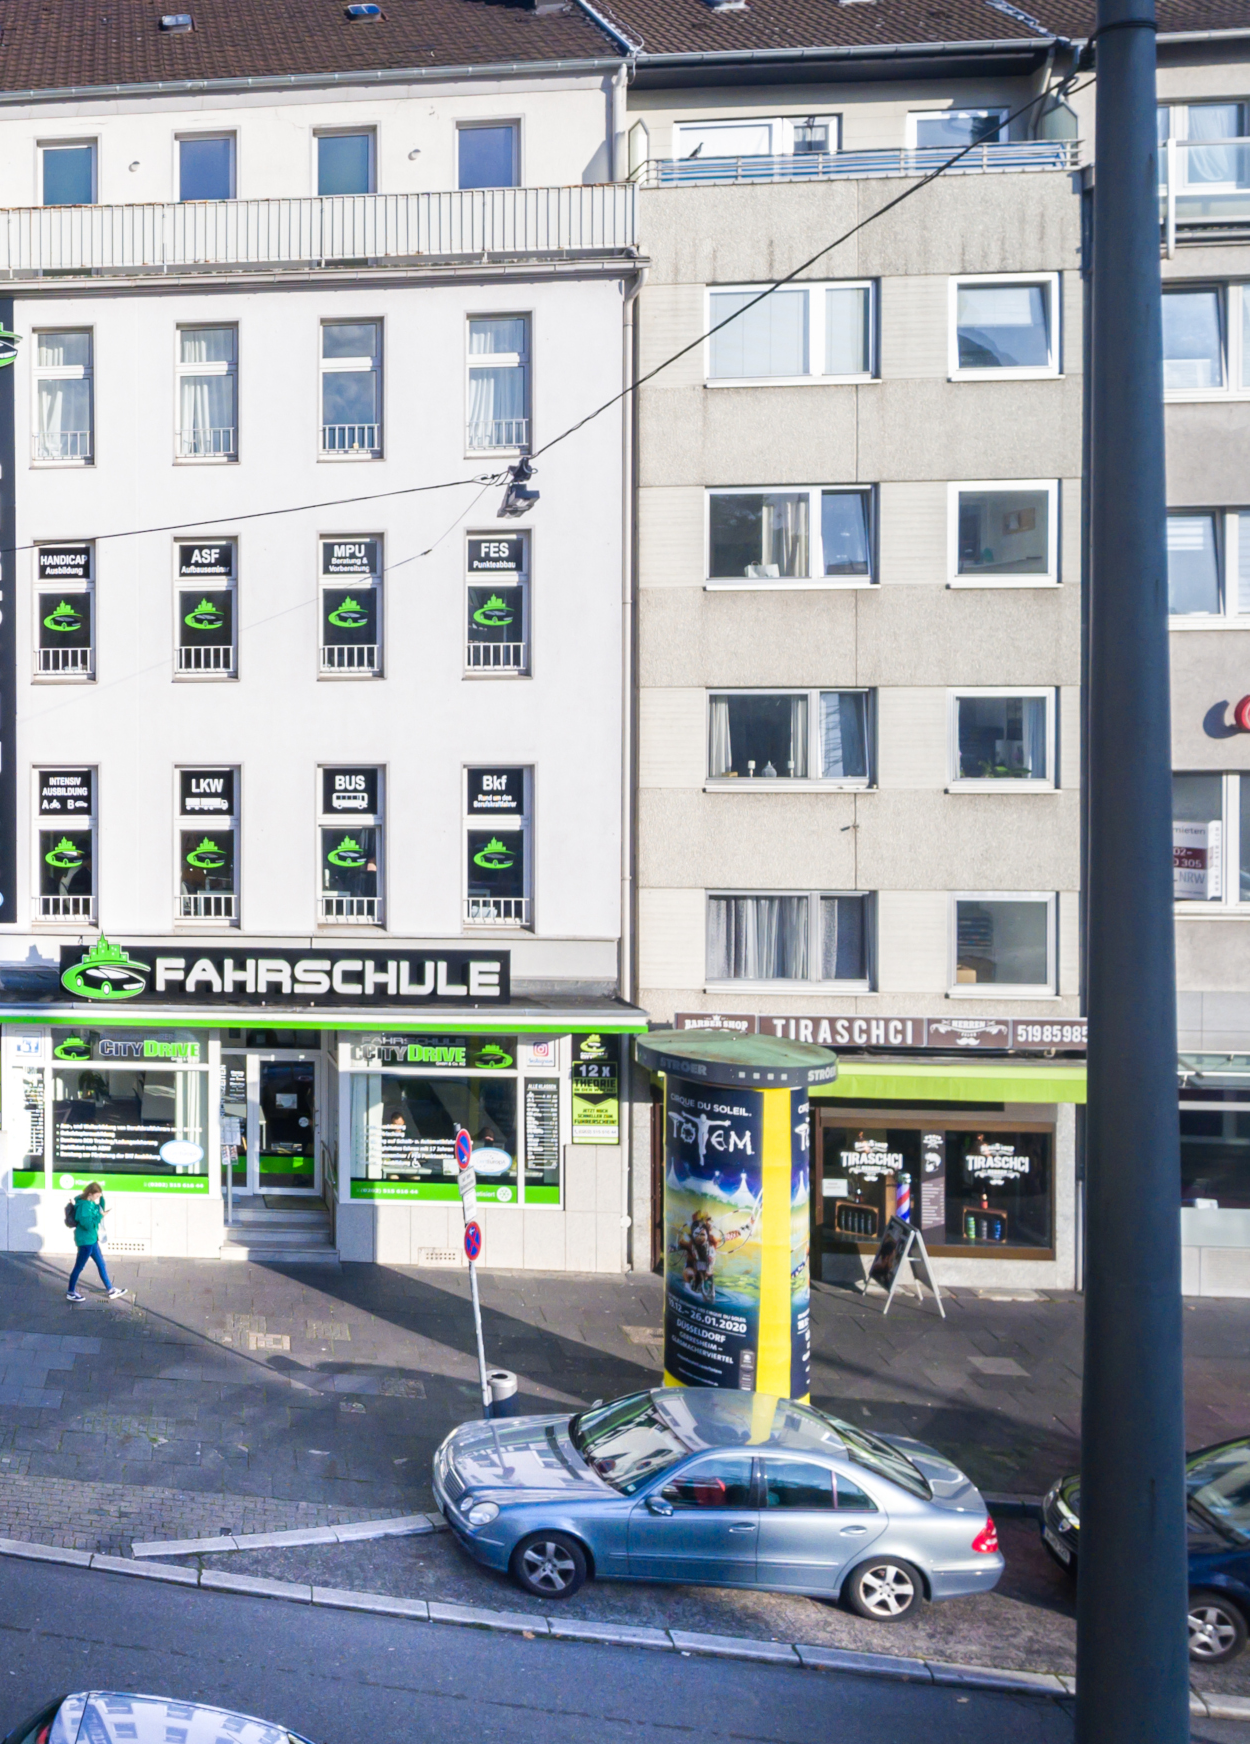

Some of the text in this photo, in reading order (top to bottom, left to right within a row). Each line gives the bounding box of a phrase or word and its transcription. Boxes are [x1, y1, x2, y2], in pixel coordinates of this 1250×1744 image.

[191, 549, 220, 564] ASF
[333, 544, 365, 557] MPU
[480, 542, 510, 558] FES
[40, 554, 88, 566] HANDICAP
[473, 560, 516, 569] Punkteabbau
[45, 566, 83, 576] Ausbildung
[181, 565, 230, 574] Aufbauseminar
[329, 564, 370, 573] Vorbereitung
[49, 776, 81, 786] INTENSIV
[191, 778, 224, 793] LKW
[335, 775, 366, 790] BUS
[482, 775, 507, 790] Bkf
[42, 787, 88, 796] AUSBILDUNG
[42, 800, 74, 809] A B
[1181, 859, 1202, 868] 305
[1179, 871, 1205, 884] NRW
[155, 956, 501, 997] FAHRSCHULE
[684, 1018, 749, 1030] BARBER SHOP
[951, 1020, 986, 1029] HERREN
[772, 1018, 913, 1045] TIRASCHCI
[361, 1036, 466, 1045] FAHRSCHULE
[579, 1064, 599, 1077] 12
[659, 1056, 707, 1076] STRÖER
[574, 1079, 616, 1087] THEORIE
[670, 1092, 696, 1108] CIRQUE
[697, 1101, 711, 1111] DU
[839, 1151, 903, 1170] TIRASCHCI
[965, 1155, 1030, 1174] TIRASCHCI
[690, 1312, 747, 1333] 26.01.2020
[676, 1318, 726, 1343] DÜSSELDORF
[679, 1331, 718, 1351] GERRESHEIM
[671, 1334, 734, 1364] GLASMACHERVIERTEL
